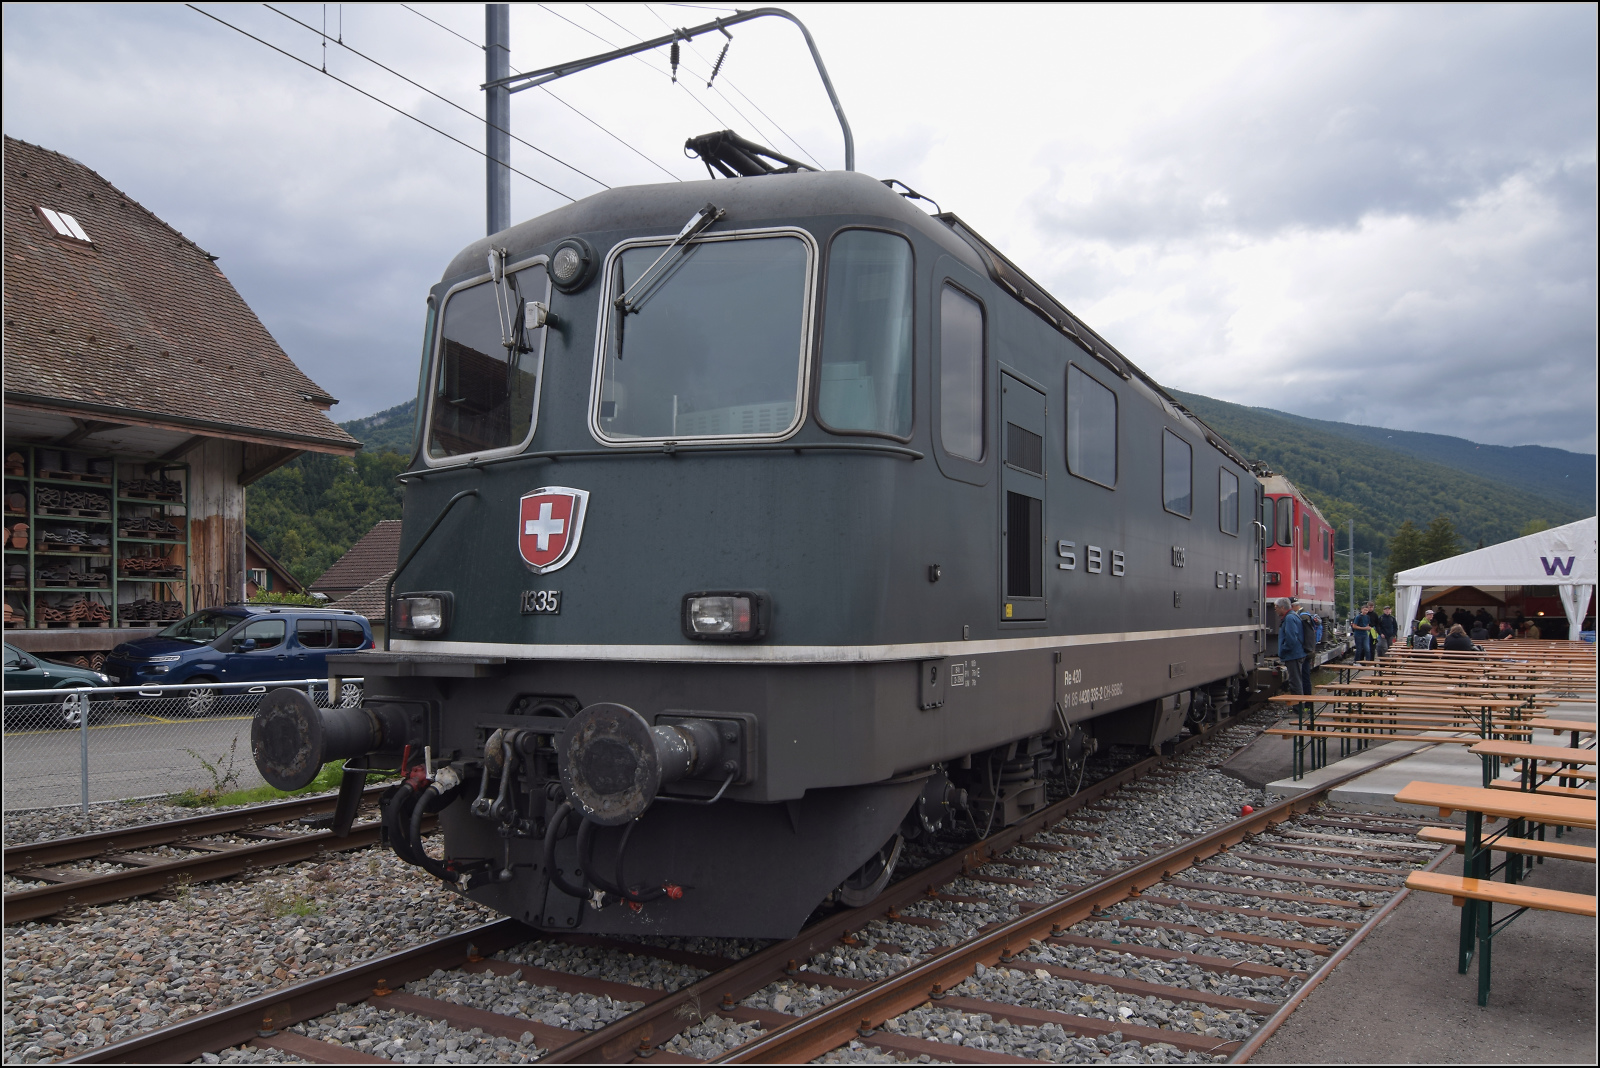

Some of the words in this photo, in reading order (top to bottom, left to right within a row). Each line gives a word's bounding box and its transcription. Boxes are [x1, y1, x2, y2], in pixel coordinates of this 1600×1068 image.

[1058, 539, 1125, 577] SBB
[1540, 556, 1576, 576] W
[1215, 571, 1242, 590] CFF
[520, 590, 558, 612] 11335
[1064, 670, 1072, 685] Re
[1072, 668, 1082, 684] 420
